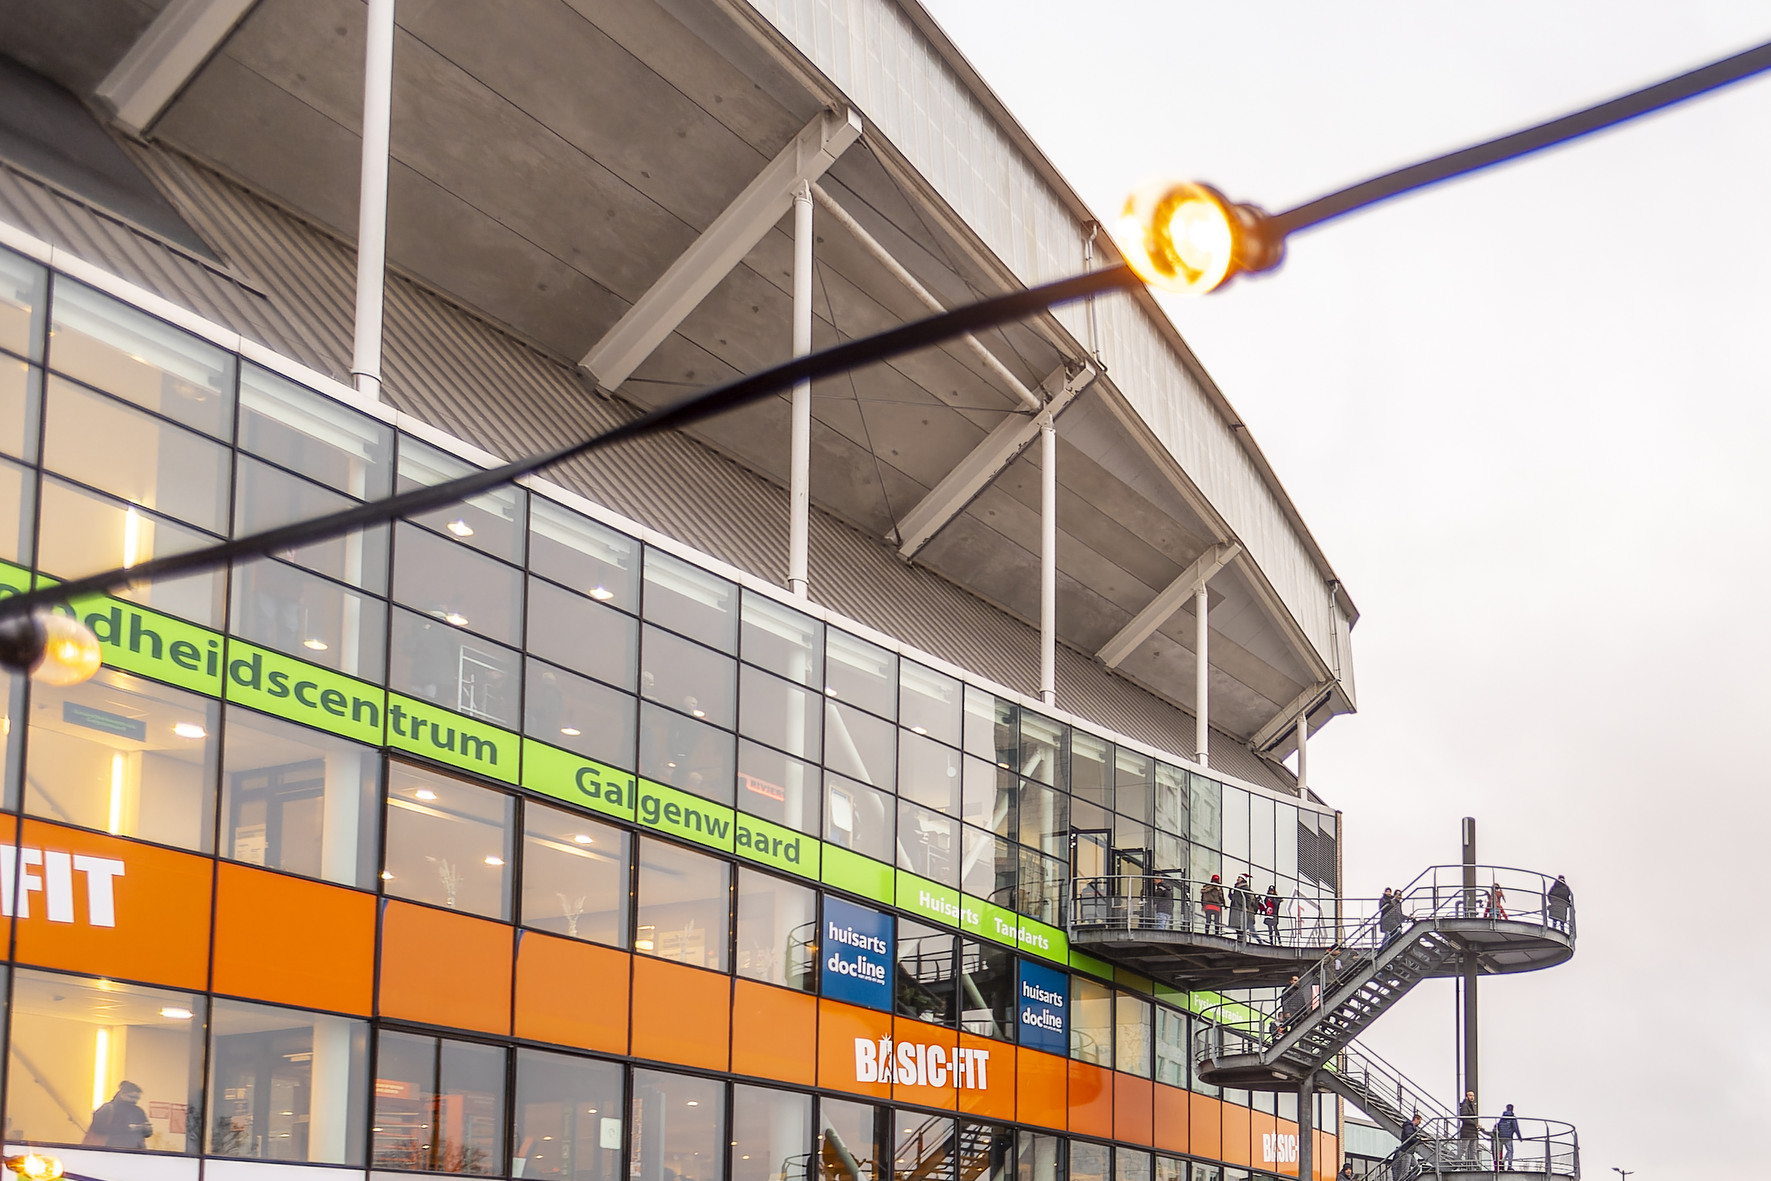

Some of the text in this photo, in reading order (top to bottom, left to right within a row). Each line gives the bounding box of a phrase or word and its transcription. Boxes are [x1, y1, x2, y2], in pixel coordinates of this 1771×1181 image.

[575, 766, 801, 865] Galgenwaard
[0, 844, 126, 928] FIT
[919, 889, 1049, 951] Huisarts Tandarts
[828, 921, 887, 955] huisarts
[827, 952, 886, 979] docline
[1022, 980, 1064, 1007] huisarts
[1022, 1007, 1063, 1028] docline
[854, 1033, 990, 1090] BASIC-FIT
[1262, 1130, 1300, 1163] BASIC-
